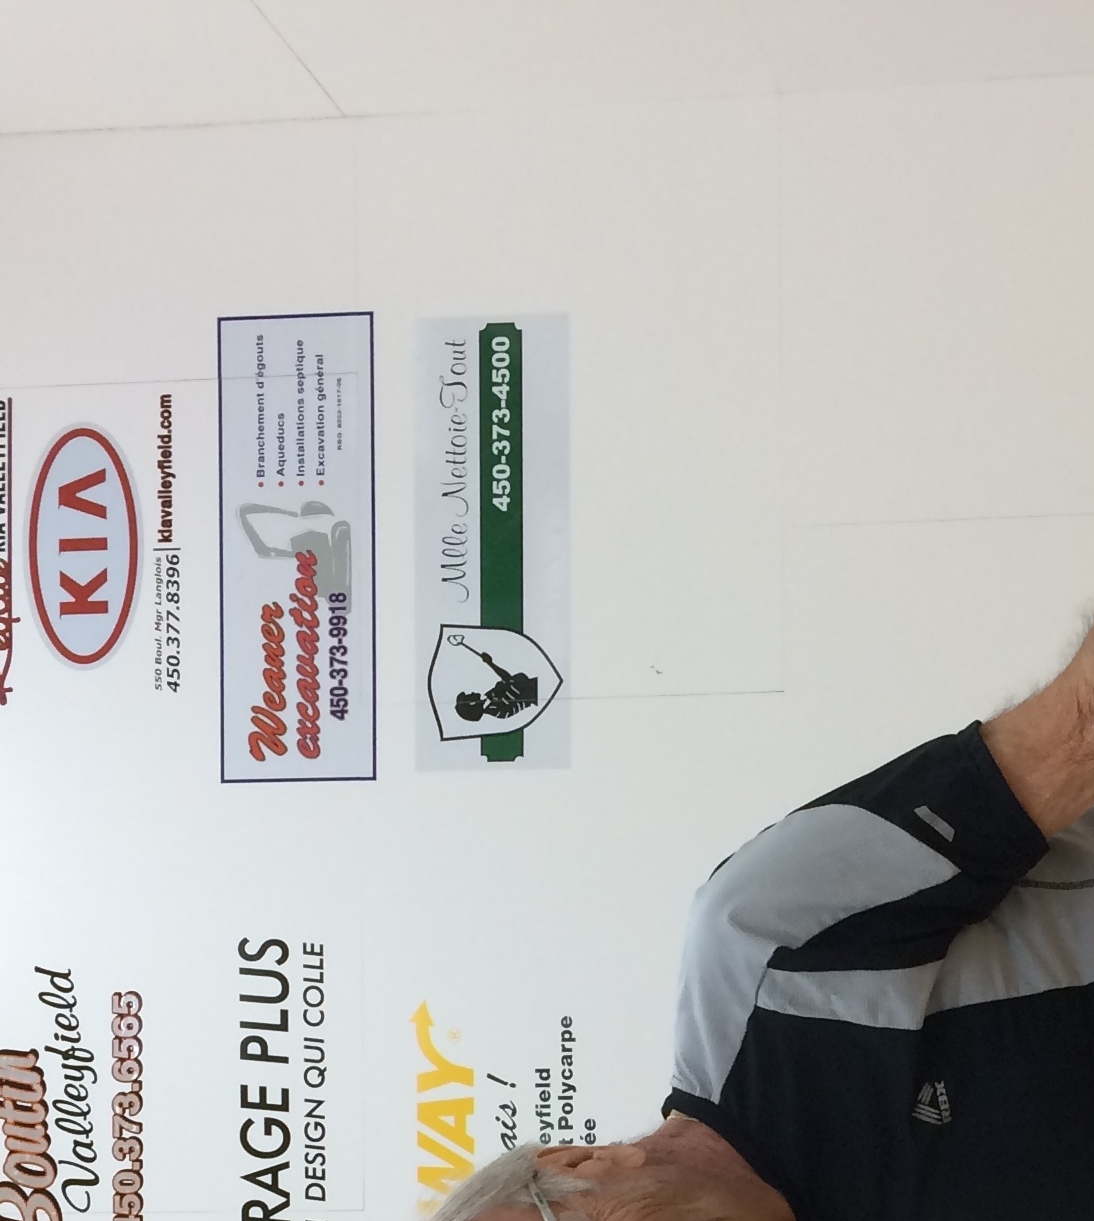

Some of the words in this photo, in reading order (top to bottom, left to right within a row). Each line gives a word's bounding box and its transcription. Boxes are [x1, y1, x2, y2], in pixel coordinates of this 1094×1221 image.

[294, 339, 307, 394] septique
[314, 353, 327, 401] général
[255, 392, 266, 478] Branchement
[275, 412, 287, 477] Aqueducs
[296, 397, 306, 477] Installations
[315, 404, 326, 476] Excavation
[491, 335, 511, 512] 450-373-4500
[58, 468, 108, 618] KIA
[153, 556, 165, 606] Langlois
[154, 608, 165, 632] Mgr
[166, 553, 181, 693] 450.377.8396
[288, 549, 321, 759] excavation
[327, 592, 349, 721] 450-373-9918
[154, 668, 163, 691] 550
[247, 601, 288, 762] Weaner
[237, 935, 290, 1064] PLUS
[302, 941, 325, 1027] COLLE
[34, 965, 100, 1213] Valleyfield
[302, 1037, 327, 1089] QUI
[410, 1000, 475, 1196] WAY
[535, 1067, 555, 1145] eyfield
[557, 1015, 577, 1130] Polycarpe
[303, 1097, 327, 1202] DESIGN
[495, 1100, 517, 1151] ais
